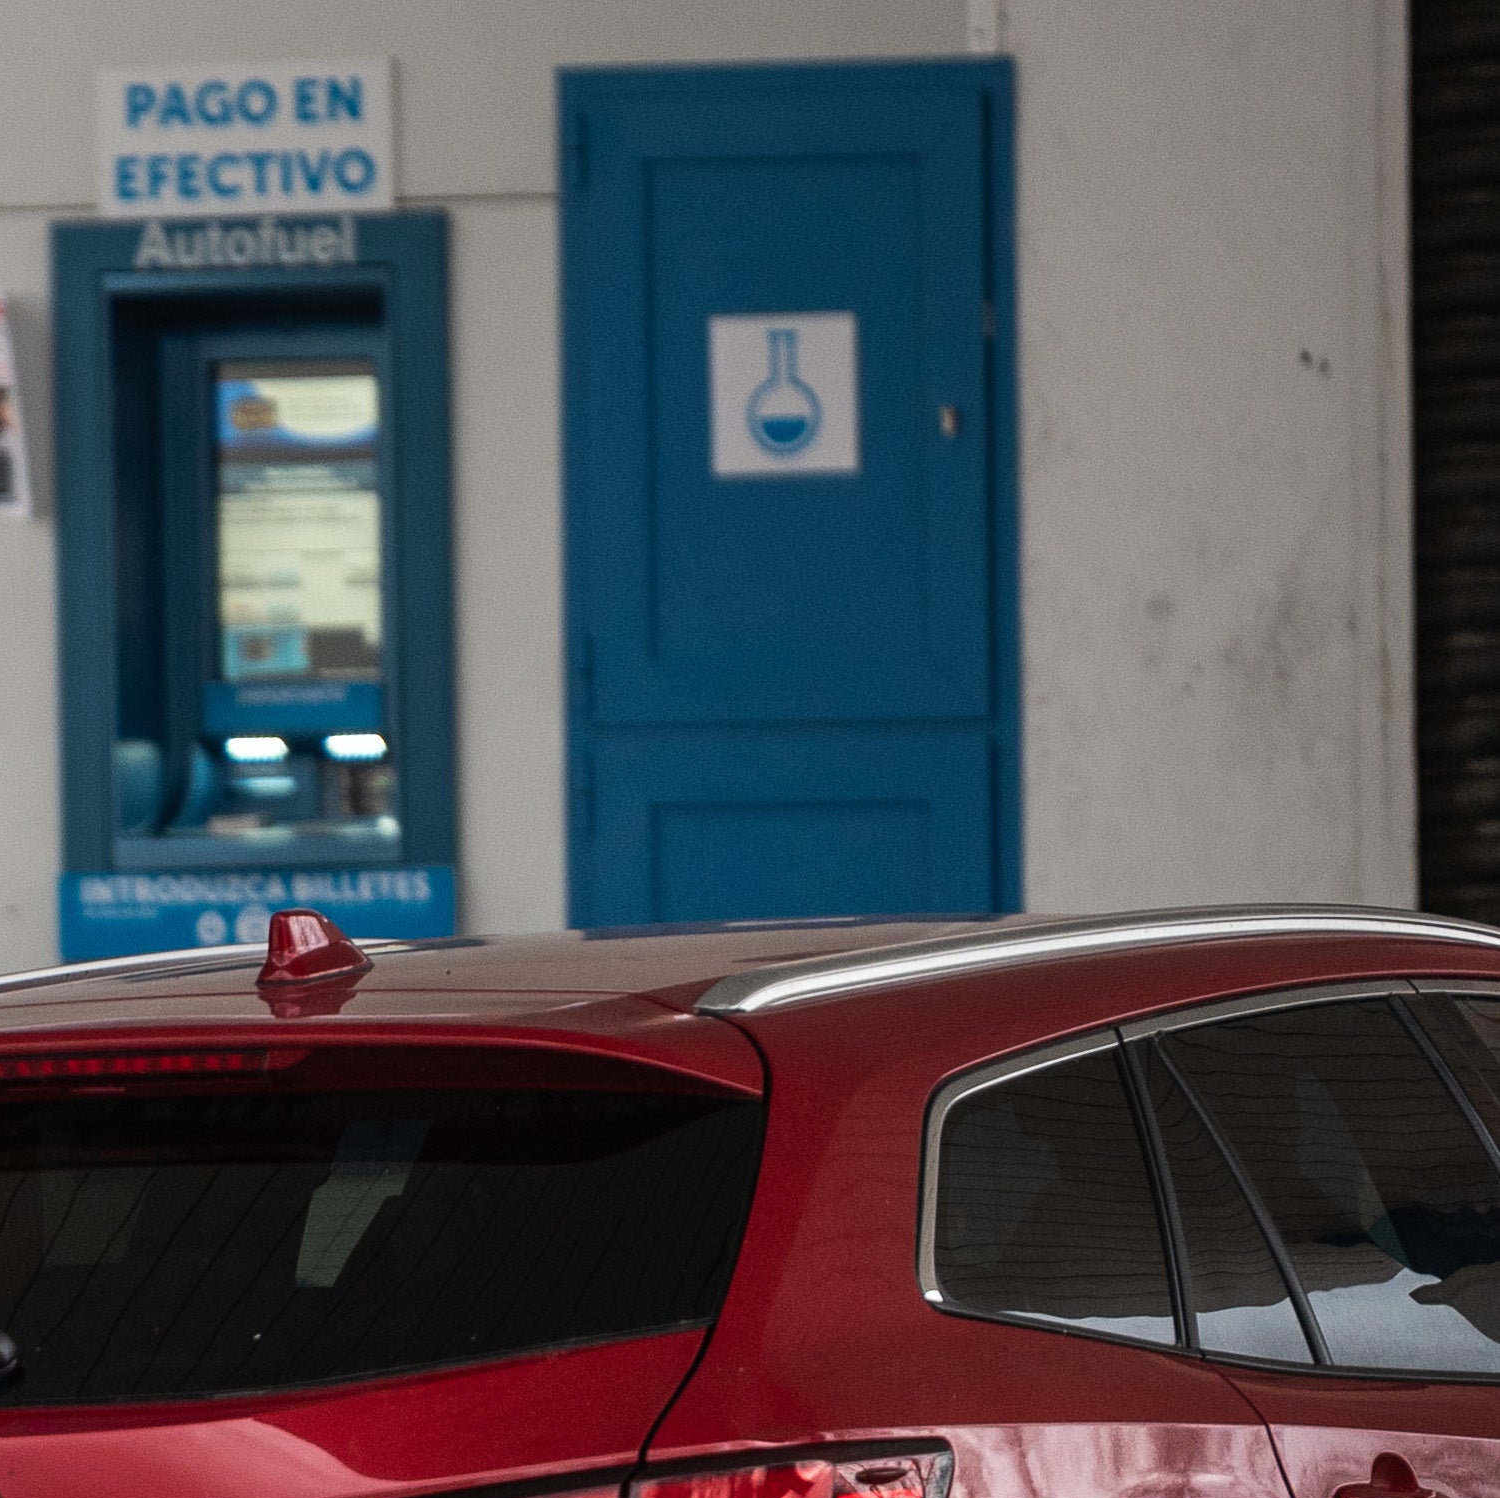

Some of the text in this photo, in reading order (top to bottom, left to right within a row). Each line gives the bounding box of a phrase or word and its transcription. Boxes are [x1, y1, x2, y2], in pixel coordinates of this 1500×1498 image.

[124, 74, 365, 129] PAGO EN
[114, 147, 378, 201] EFECTIVO
[133, 213, 357, 267] Autofuel
[290, 870, 433, 903] BILLETES
